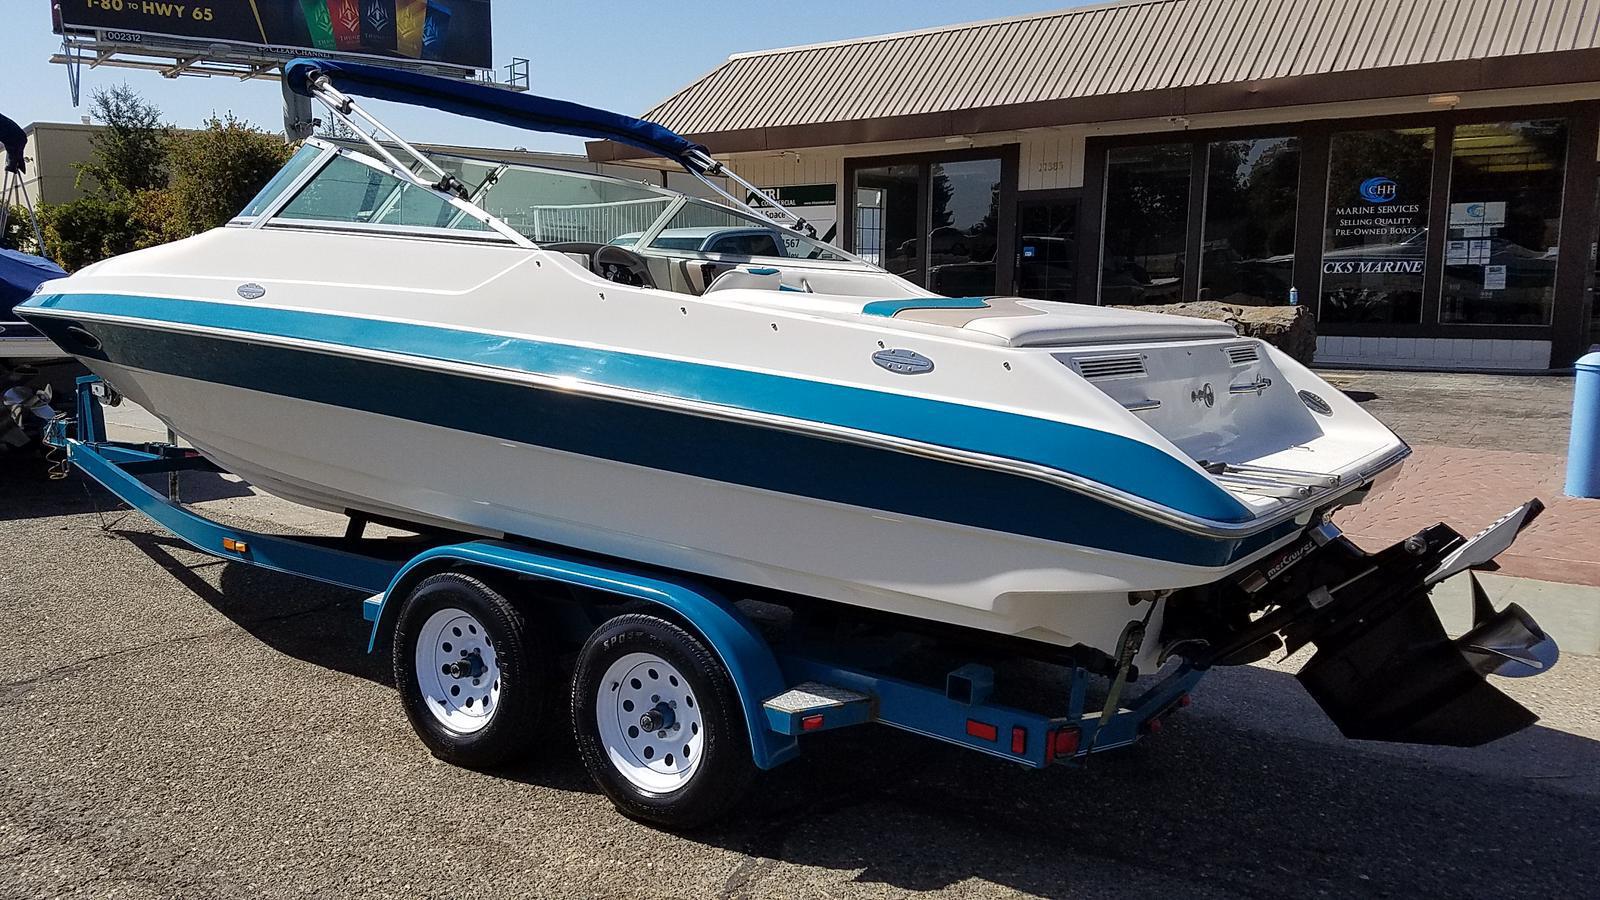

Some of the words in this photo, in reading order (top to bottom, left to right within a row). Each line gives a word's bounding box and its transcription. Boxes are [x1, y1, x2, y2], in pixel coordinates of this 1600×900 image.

[128, 2, 139, 10] TO
[142, 1, 185, 18] HWY
[192, 7, 214, 21] 65
[107, 31, 141, 42] 002312
[761, 188, 780, 200] TRI
[1368, 185, 1397, 195] CHH
[760, 199, 796, 207] COERCIAL
[1336, 206, 1375, 216] MARINE
[1377, 204, 1420, 214] SERVICES
[782, 238, 800, 248] 567
[1323, 261, 1355, 274] CKS
[1357, 260, 1424, 273] MARINE
